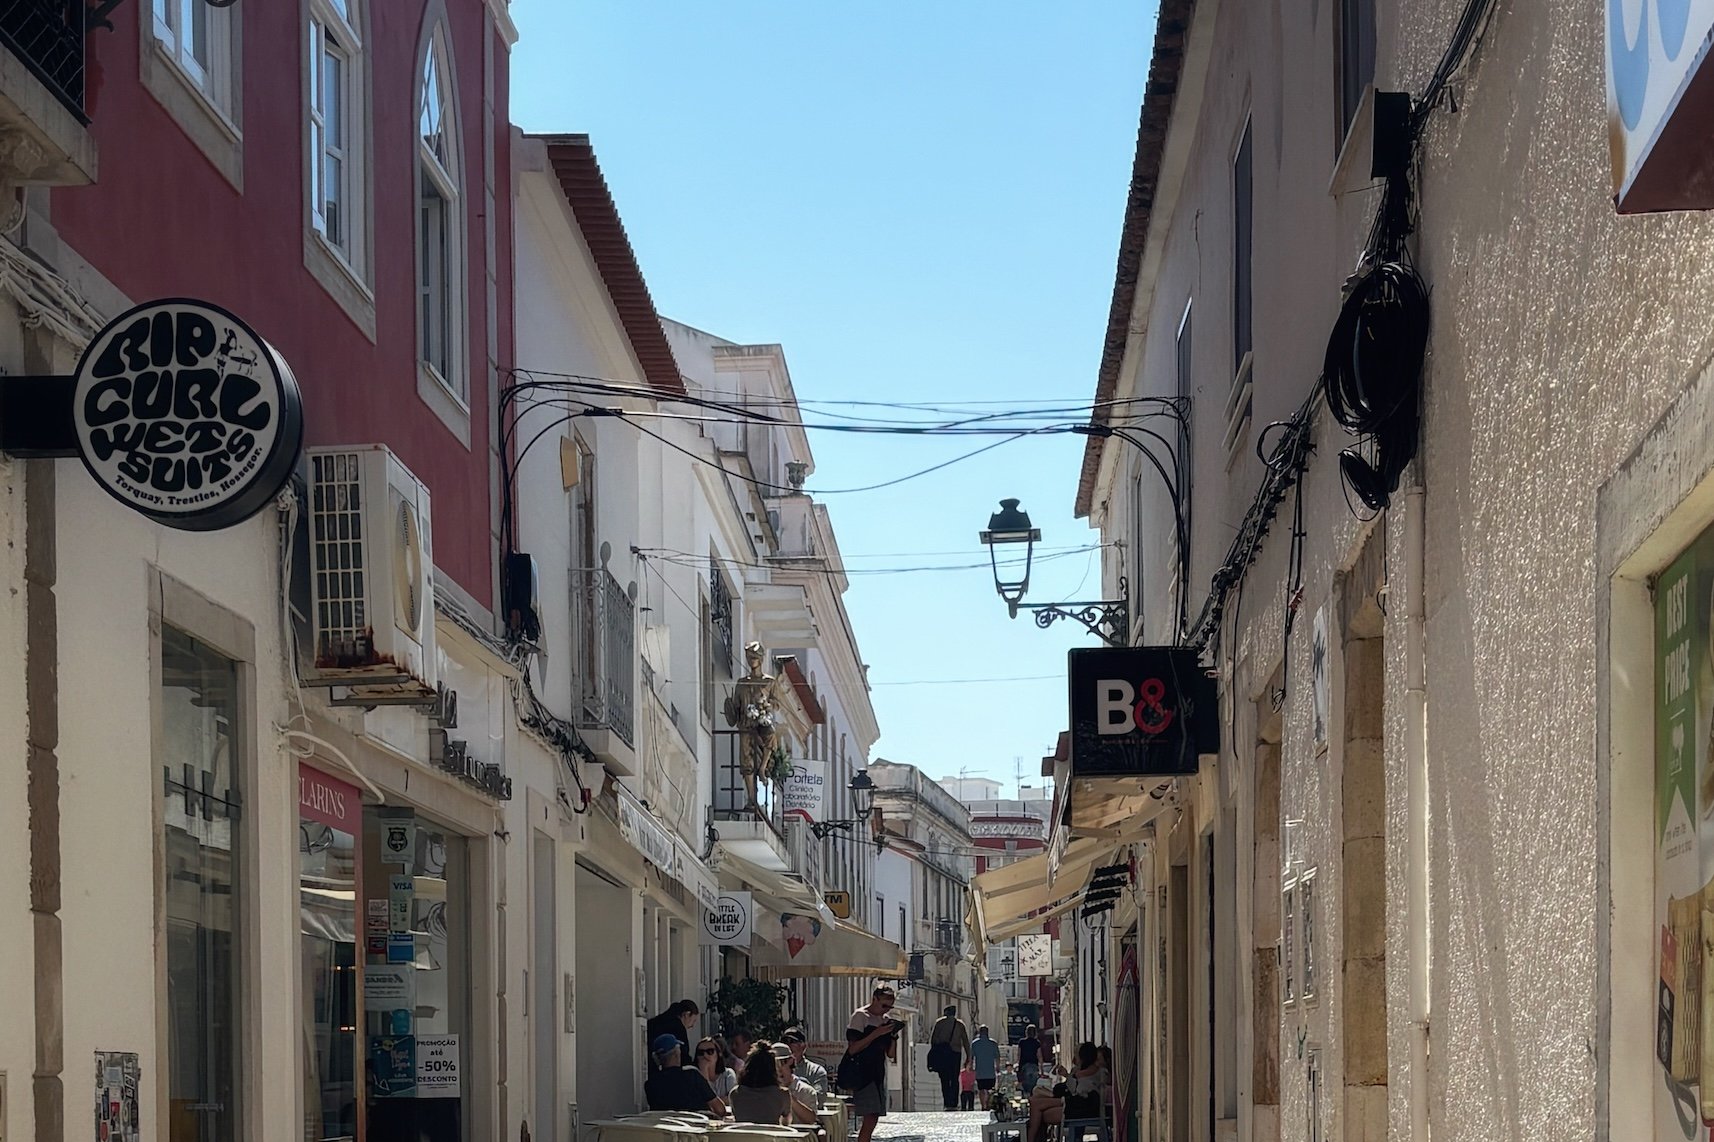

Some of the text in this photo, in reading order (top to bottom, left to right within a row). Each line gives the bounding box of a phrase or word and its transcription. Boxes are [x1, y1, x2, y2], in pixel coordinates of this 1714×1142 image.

[92, 311, 216, 378] RIP
[84, 368, 271, 431] CURL
[115, 475, 163, 505] Torquay,
[1666, 573, 1688, 639] BEST
[1665, 639, 1690, 705] PRICE
[299, 777, 345, 820] LARINS
[784, 793, 821, 802] aboratório
[393, 882, 413, 890] VISA
[825, 895, 843, 904] TM
[709, 912, 740, 925] BREAK
[416, 1039, 456, 1047] PROMOÇÃO
[430, 1048, 443, 1056] até
[418, 1060, 456, 1072] -50%
[417, 1075, 458, 1083] DESCONTO
